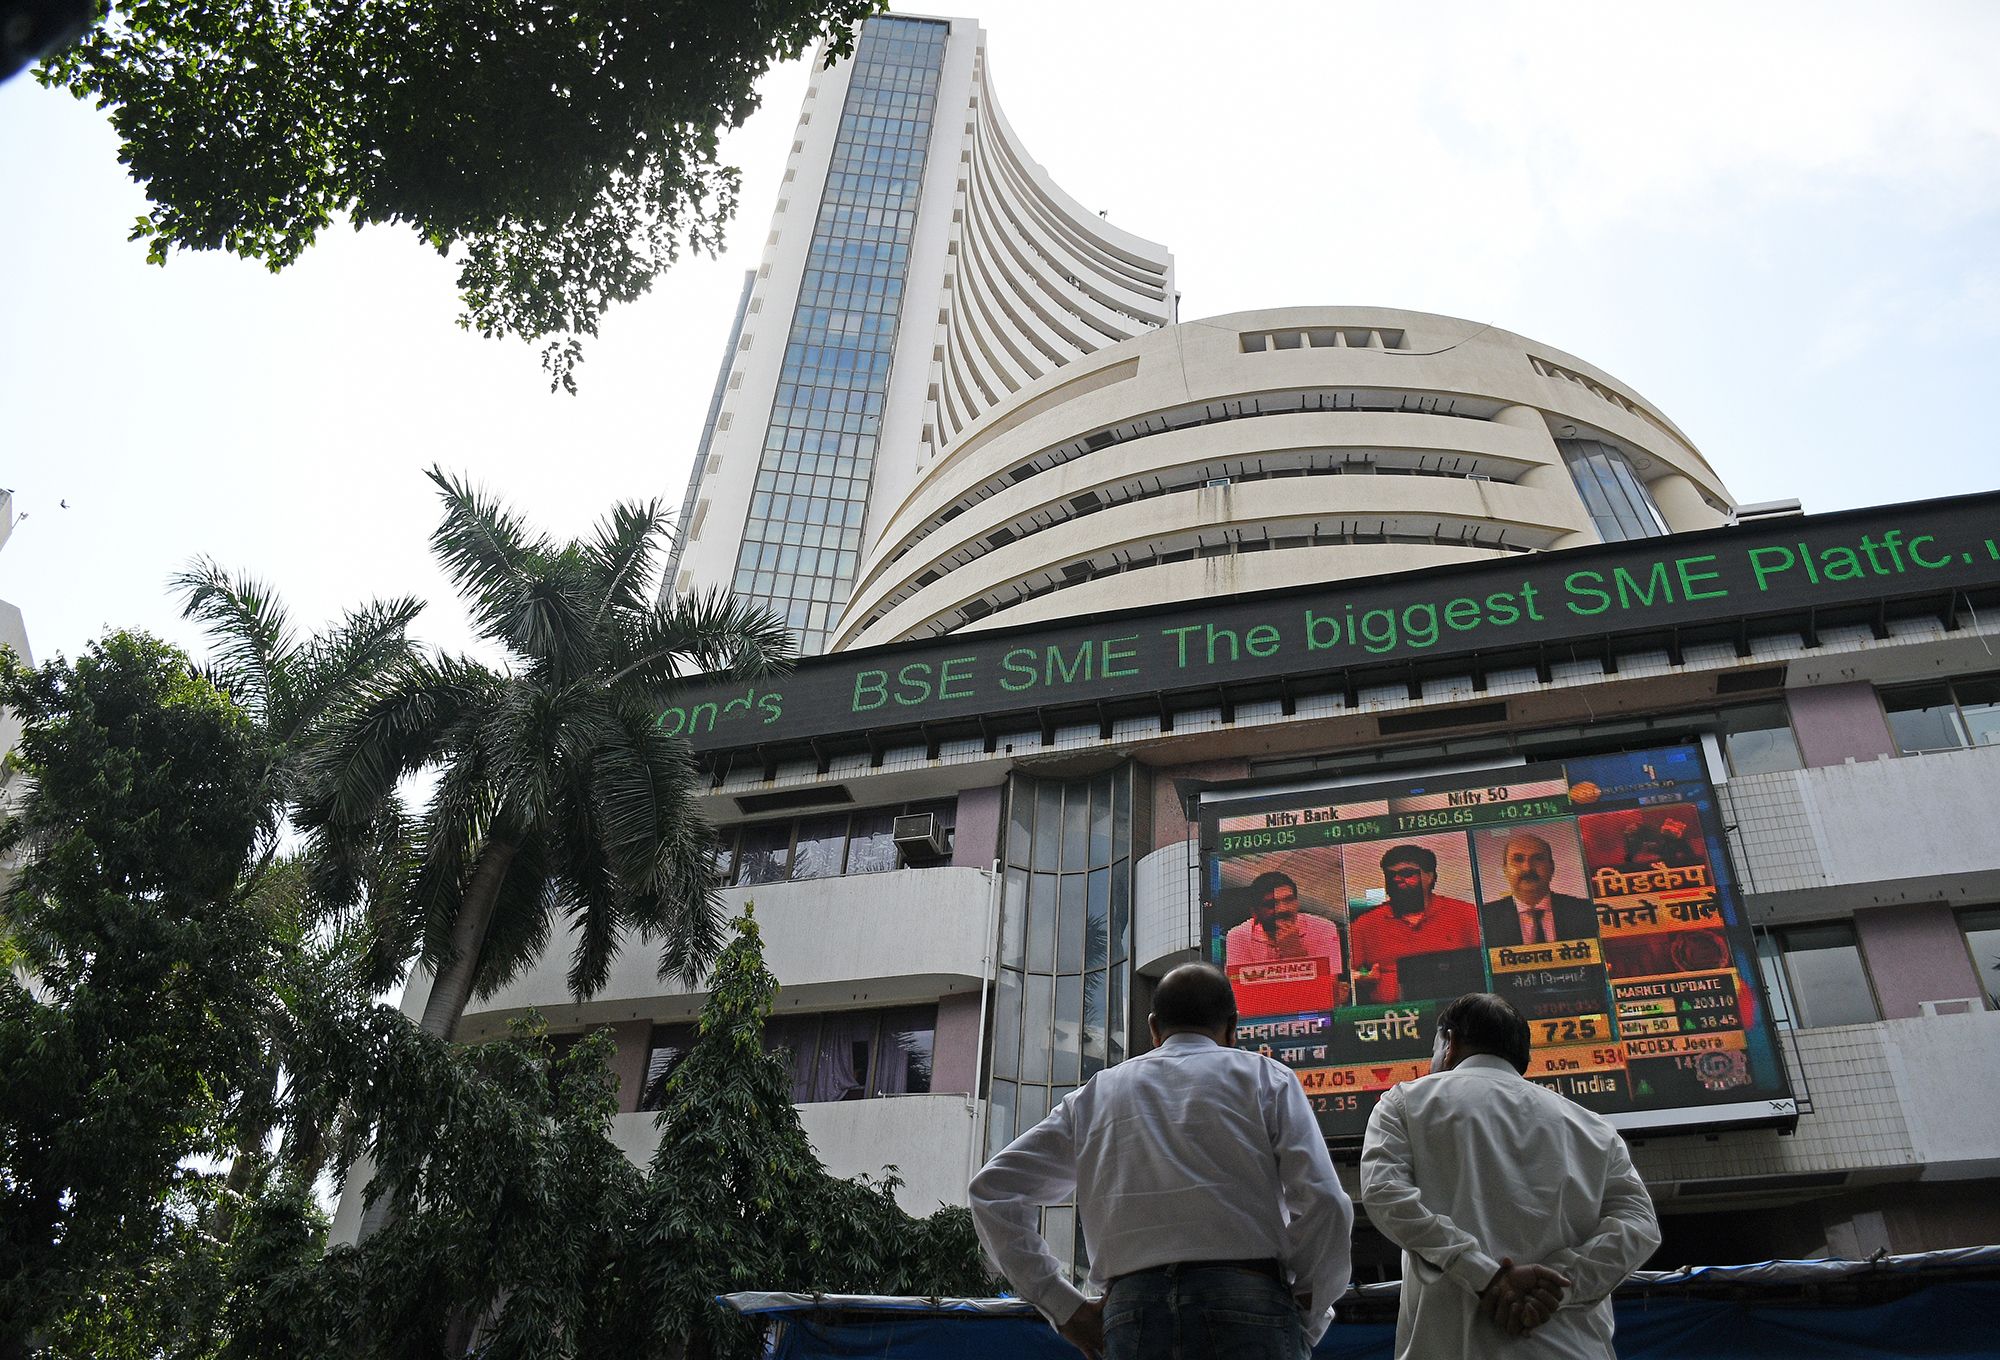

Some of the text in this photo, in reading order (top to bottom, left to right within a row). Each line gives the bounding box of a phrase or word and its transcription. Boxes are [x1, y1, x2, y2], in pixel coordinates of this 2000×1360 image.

[852, 656, 977, 712] BSE
[999, 634, 1140, 692] SME
[1162, 623, 1281, 668] The
[1305, 581, 1545, 653] biggest
[1564, 554, 1729, 615] SME
[1447, 787, 1508, 807] Nifty 50
[1265, 806, 1339, 828] Nifty Bank
[1398, 801, 1558, 830] 17860.65 +0.21%
[1223, 821, 1380, 851] 37809.05 +0.10%
[1591, 861, 1706, 897] मिडकैप
[1499, 948, 1553, 967] विकास
[1616, 978, 1721, 999] MARKET UPDATE
[1354, 1008, 1420, 1041] खरीदें
[1541, 1018, 1597, 1042] 725
[1653, 1019, 1669, 1031] 50
[1626, 1041, 1676, 1055] NCDEX
[1303, 1070, 1357, 1089] 47.05
[1571, 1074, 1616, 1095] India
